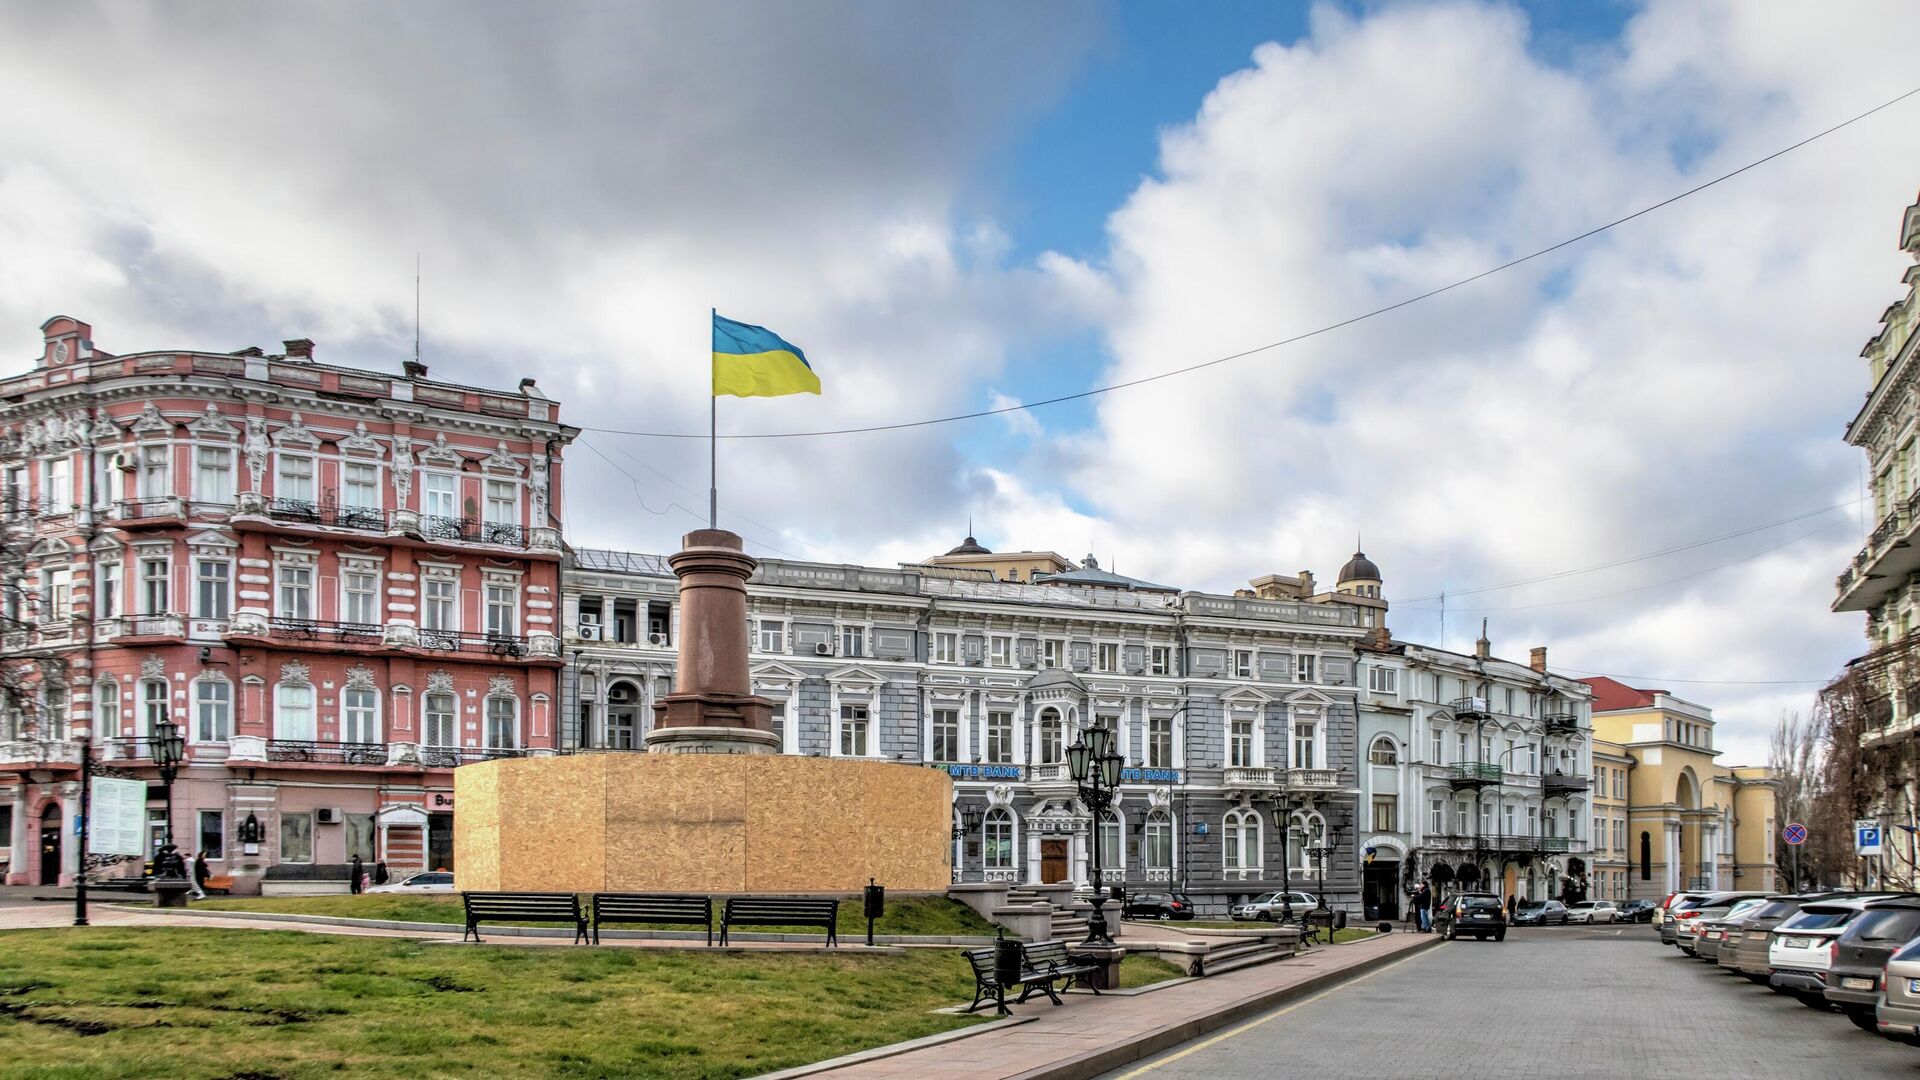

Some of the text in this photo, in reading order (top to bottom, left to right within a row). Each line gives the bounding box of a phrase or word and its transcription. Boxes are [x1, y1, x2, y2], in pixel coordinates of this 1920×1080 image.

[950, 764, 1020, 778] MTB BANK
[1144, 769, 1180, 781] BANK
[435, 794, 454, 808] Bu
[1863, 830, 1876, 845] P
